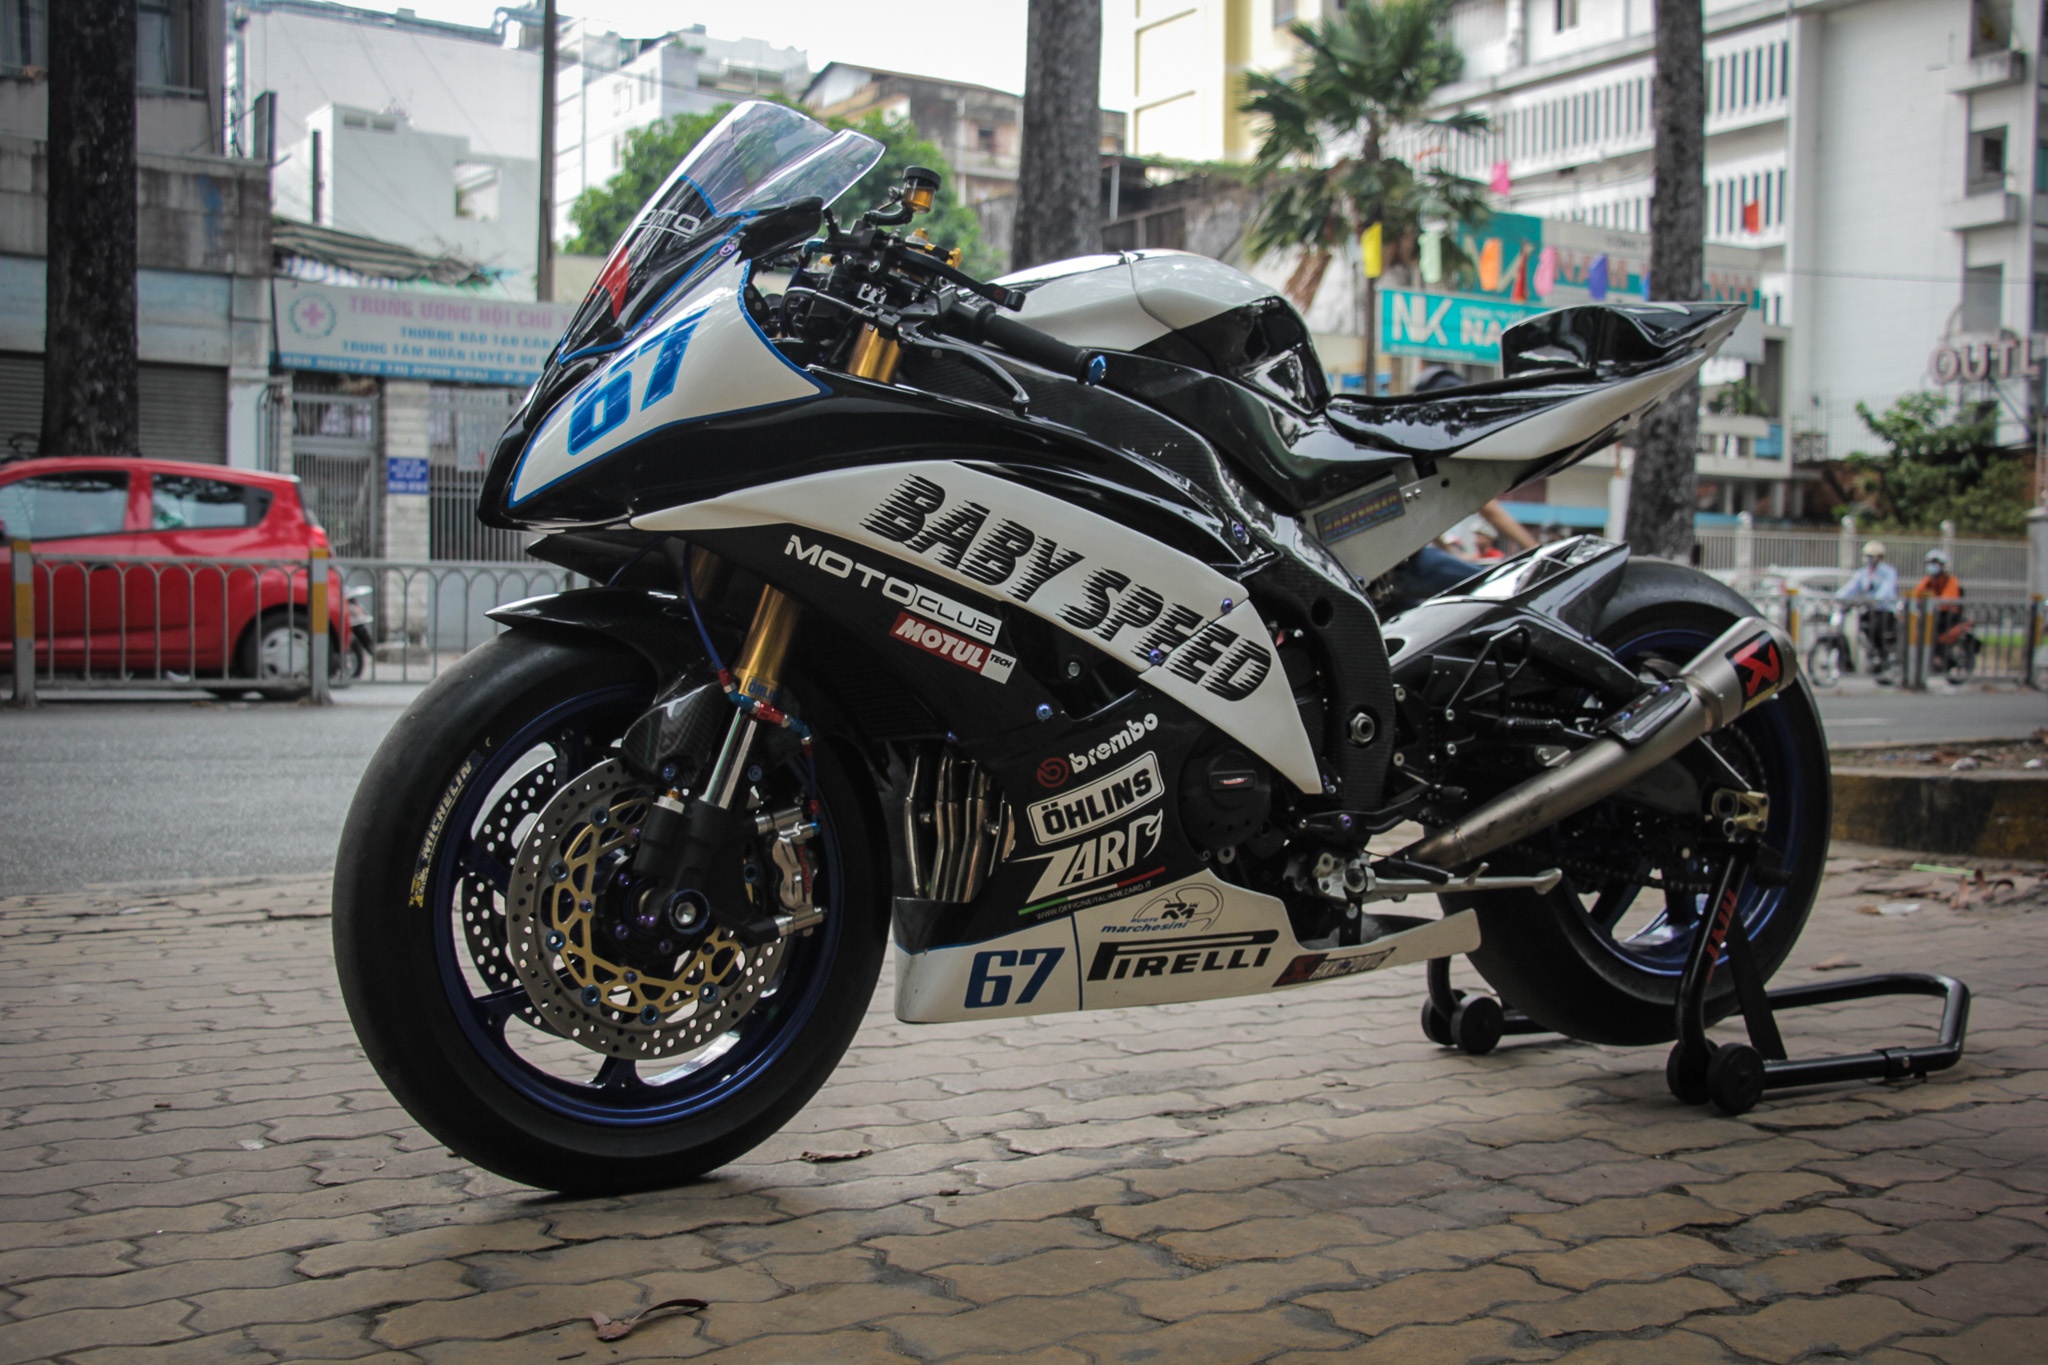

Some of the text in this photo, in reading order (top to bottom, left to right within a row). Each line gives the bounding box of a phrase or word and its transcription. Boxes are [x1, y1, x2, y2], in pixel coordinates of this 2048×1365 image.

[350, 295, 413, 318] TRUNG
[1391, 292, 1453, 346] NK
[1461, 317, 1508, 347] NA
[568, 306, 712, 456] 67
[859, 473, 1272, 702] BABY SPEED
[897, 618, 1013, 669] MOTUL TECH
[1069, 713, 1159, 774] brembo
[421, 760, 473, 860] MICHELIN
[1041, 767, 1153, 836] ÖHLINS
[1100, 919, 1189, 934] marchesini
[963, 946, 1066, 1010] 67
[1086, 929, 1280, 983] PIRELLI
